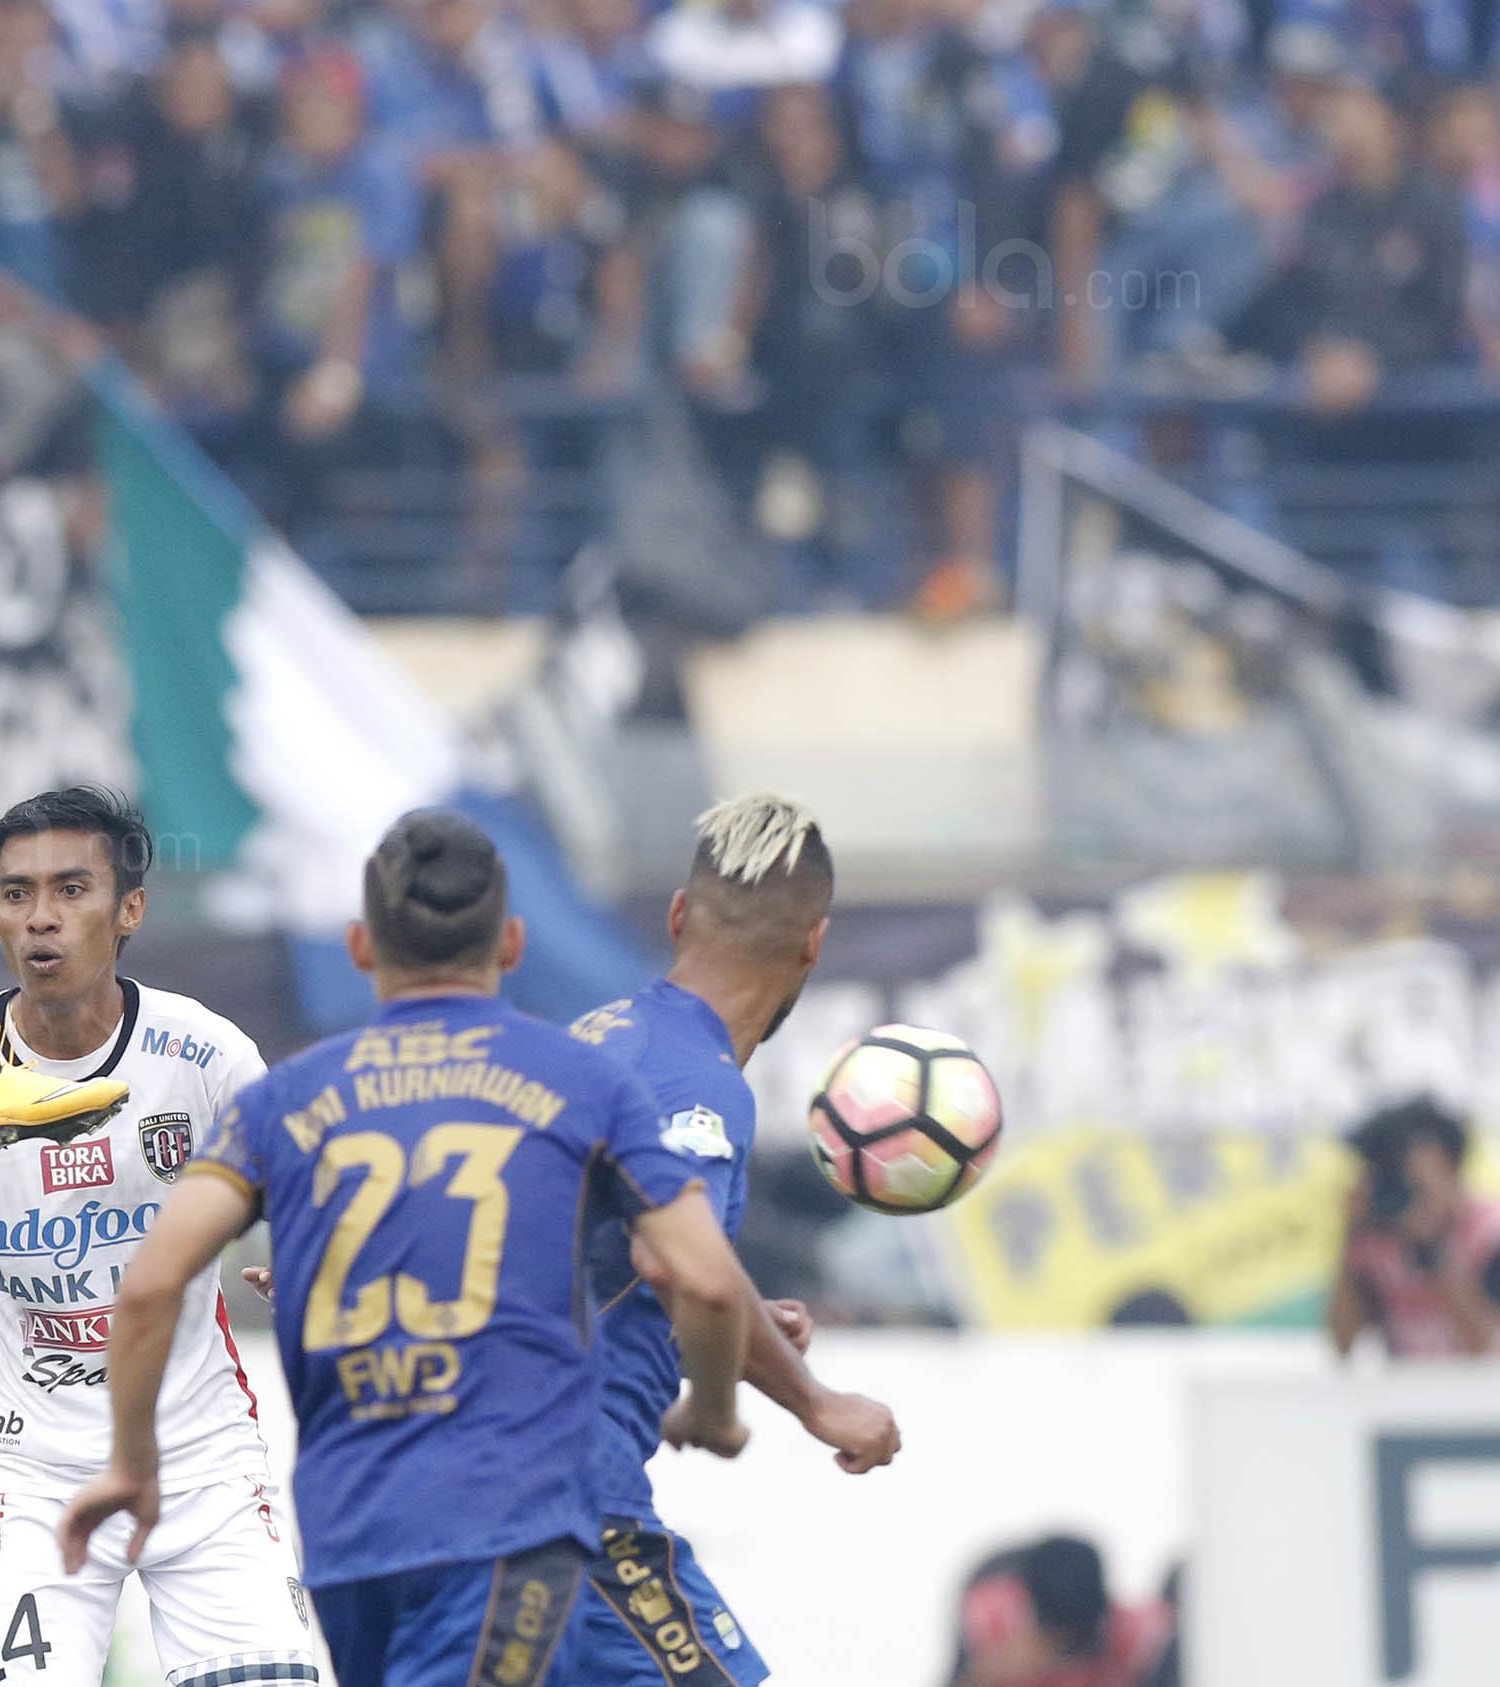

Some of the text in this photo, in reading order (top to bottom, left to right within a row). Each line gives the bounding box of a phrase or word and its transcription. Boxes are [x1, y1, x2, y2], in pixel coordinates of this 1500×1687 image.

[142, 1028, 216, 1069] Mobil
[344, 1024, 506, 1071] ABC
[159, 1113, 188, 1123] UNITED
[354, 1061, 567, 1131] KURNIAWAN
[44, 1145, 106, 1168] TORA
[50, 1165, 106, 1186] BIKA
[303, 1122, 526, 1350] 23
[337, 1343, 461, 1402] FWD
[656, 1620, 701, 1674] GO
